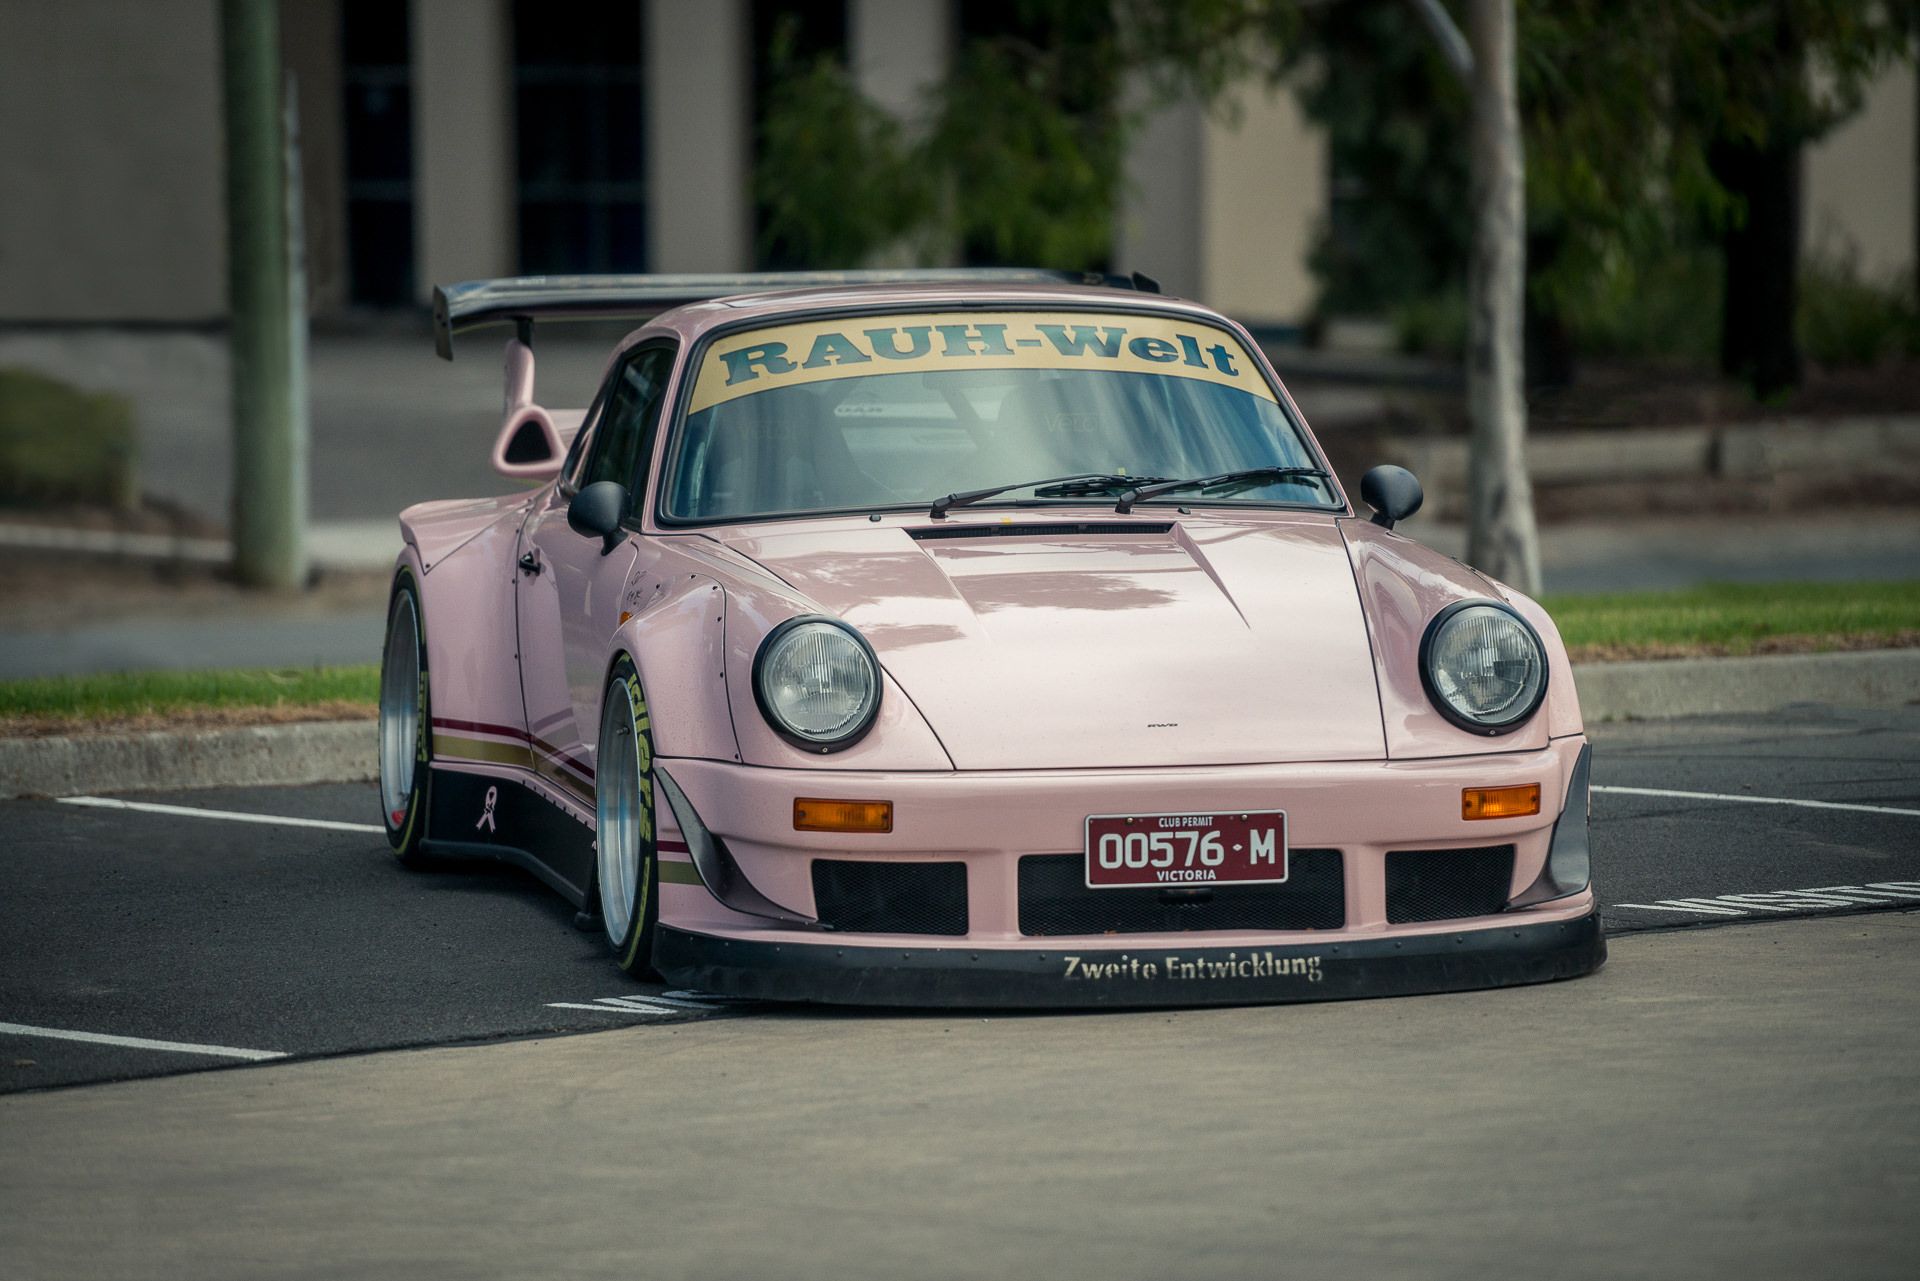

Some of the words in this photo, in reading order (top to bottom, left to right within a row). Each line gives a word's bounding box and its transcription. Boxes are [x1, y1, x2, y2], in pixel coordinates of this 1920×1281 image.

[720, 322, 1240, 387] RAUH-Welt
[1158, 816, 1181, 828] CLUB
[1182, 816, 1213, 827] PERMIT
[1157, 869, 1217, 881] VICTORIA
[1063, 955, 1158, 981] Zweite
[1165, 952, 1323, 982] Entwicklung
